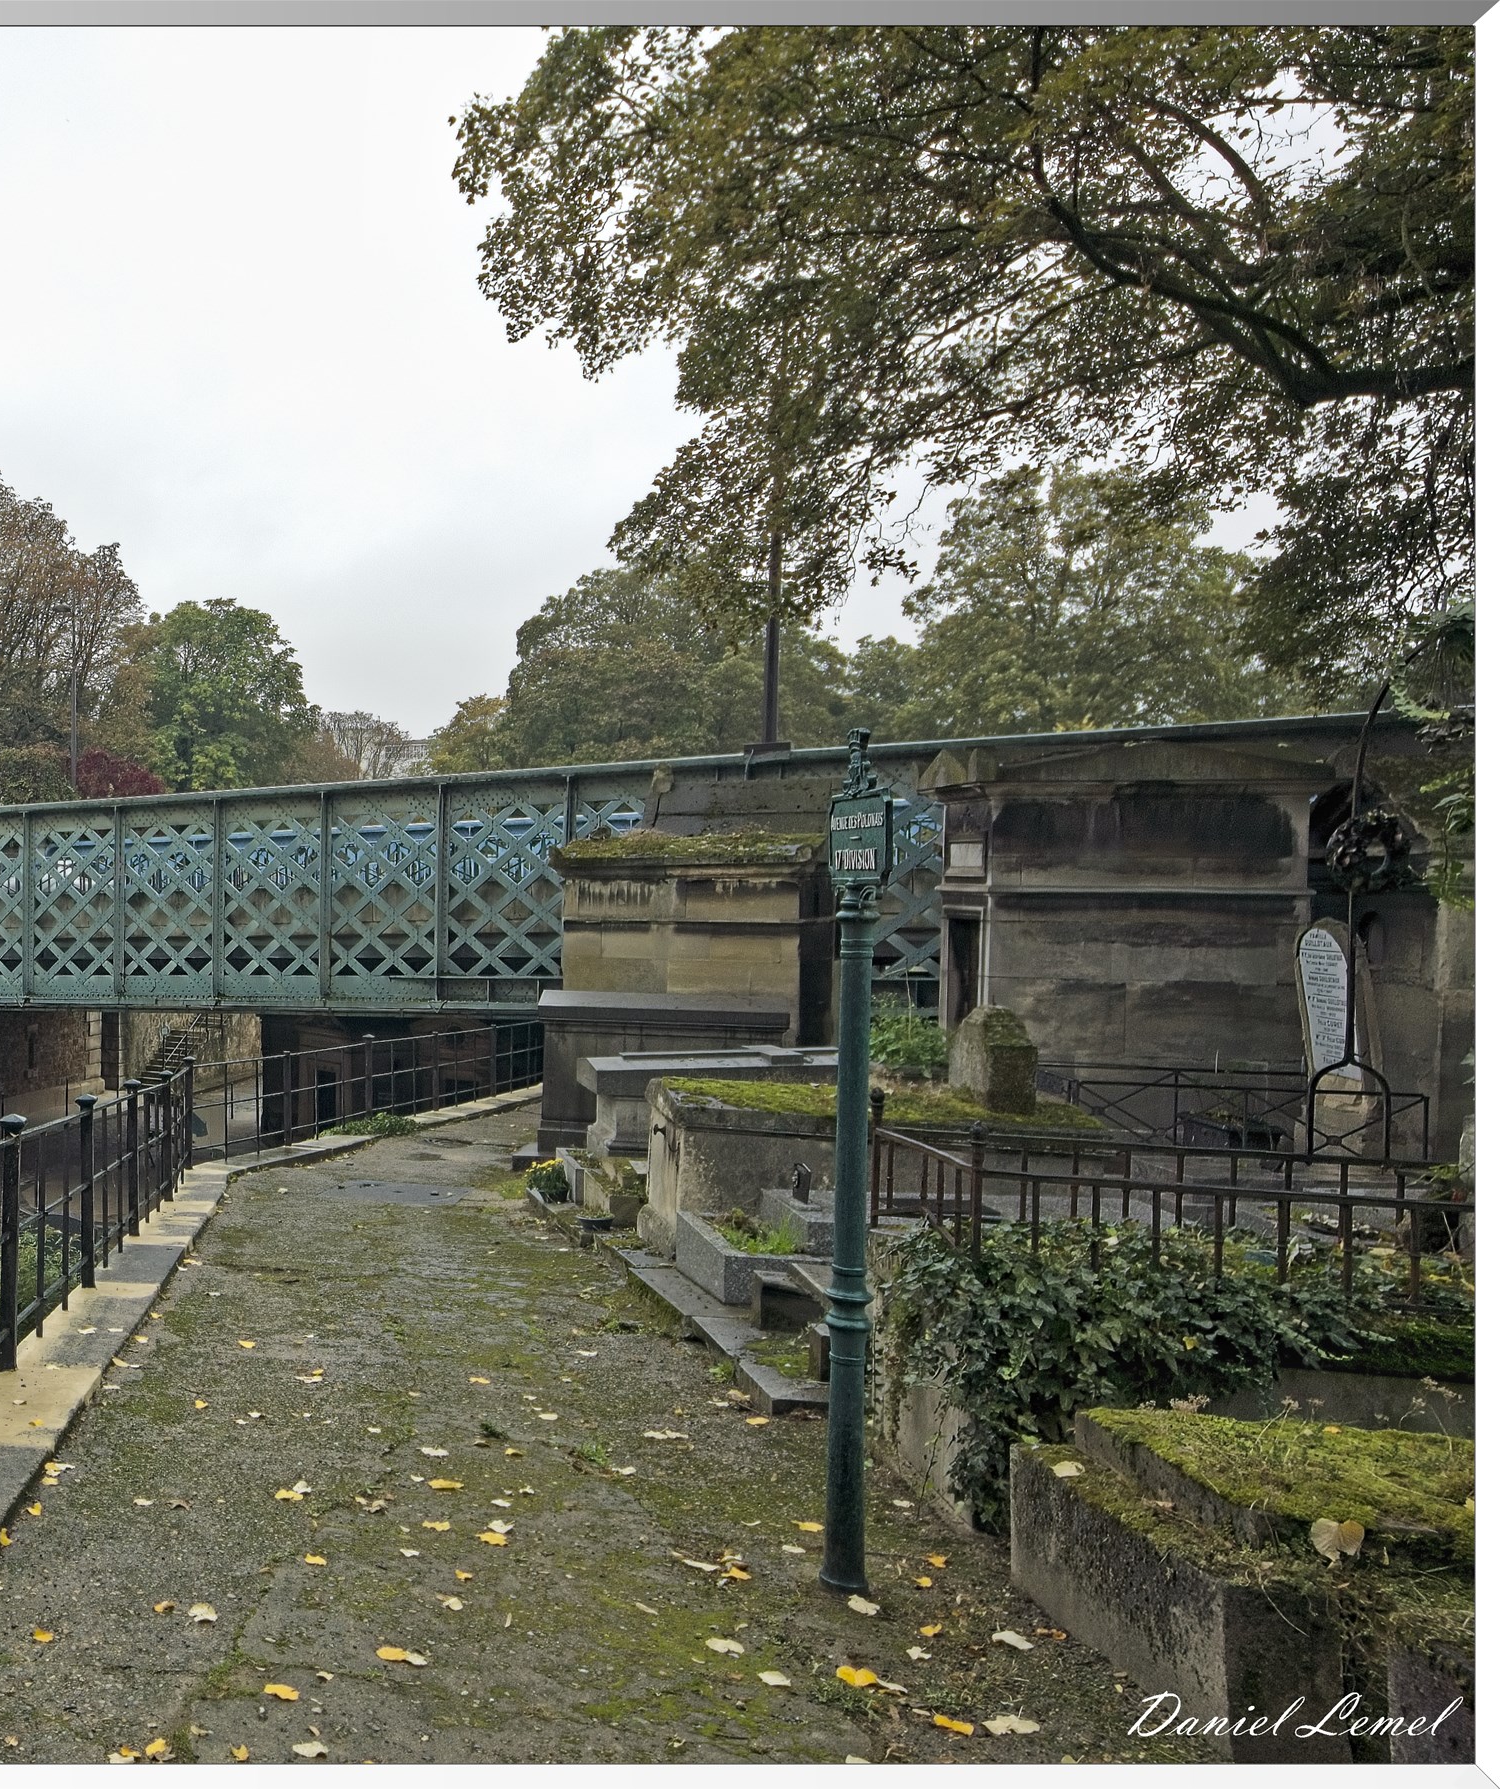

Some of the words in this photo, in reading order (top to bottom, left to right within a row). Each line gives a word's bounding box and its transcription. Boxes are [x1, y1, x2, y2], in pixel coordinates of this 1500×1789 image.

[831, 814, 848, 831] AVENUE
[848, 815, 857, 829] DES
[857, 811, 884, 829] POLONAIS
[844, 846, 877, 870] DIVISION
